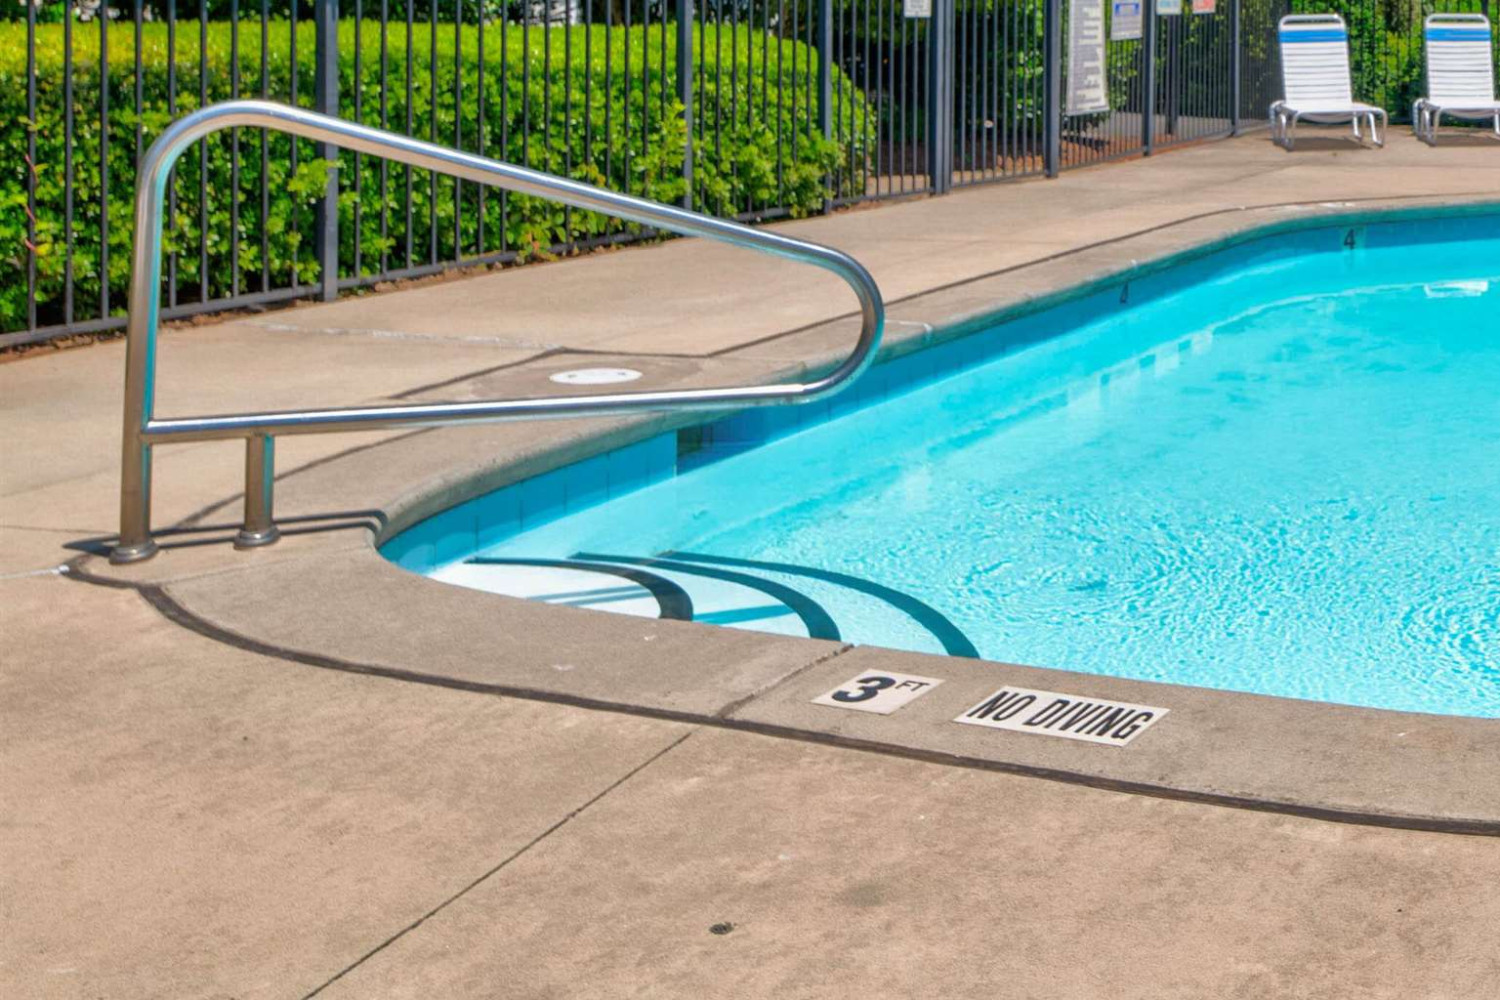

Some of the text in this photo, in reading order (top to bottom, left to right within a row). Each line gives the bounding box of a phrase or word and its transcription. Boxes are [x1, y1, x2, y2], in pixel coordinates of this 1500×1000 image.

[831, 676, 930, 702] 3 FT
[966, 691, 1154, 739] NO DIVING
